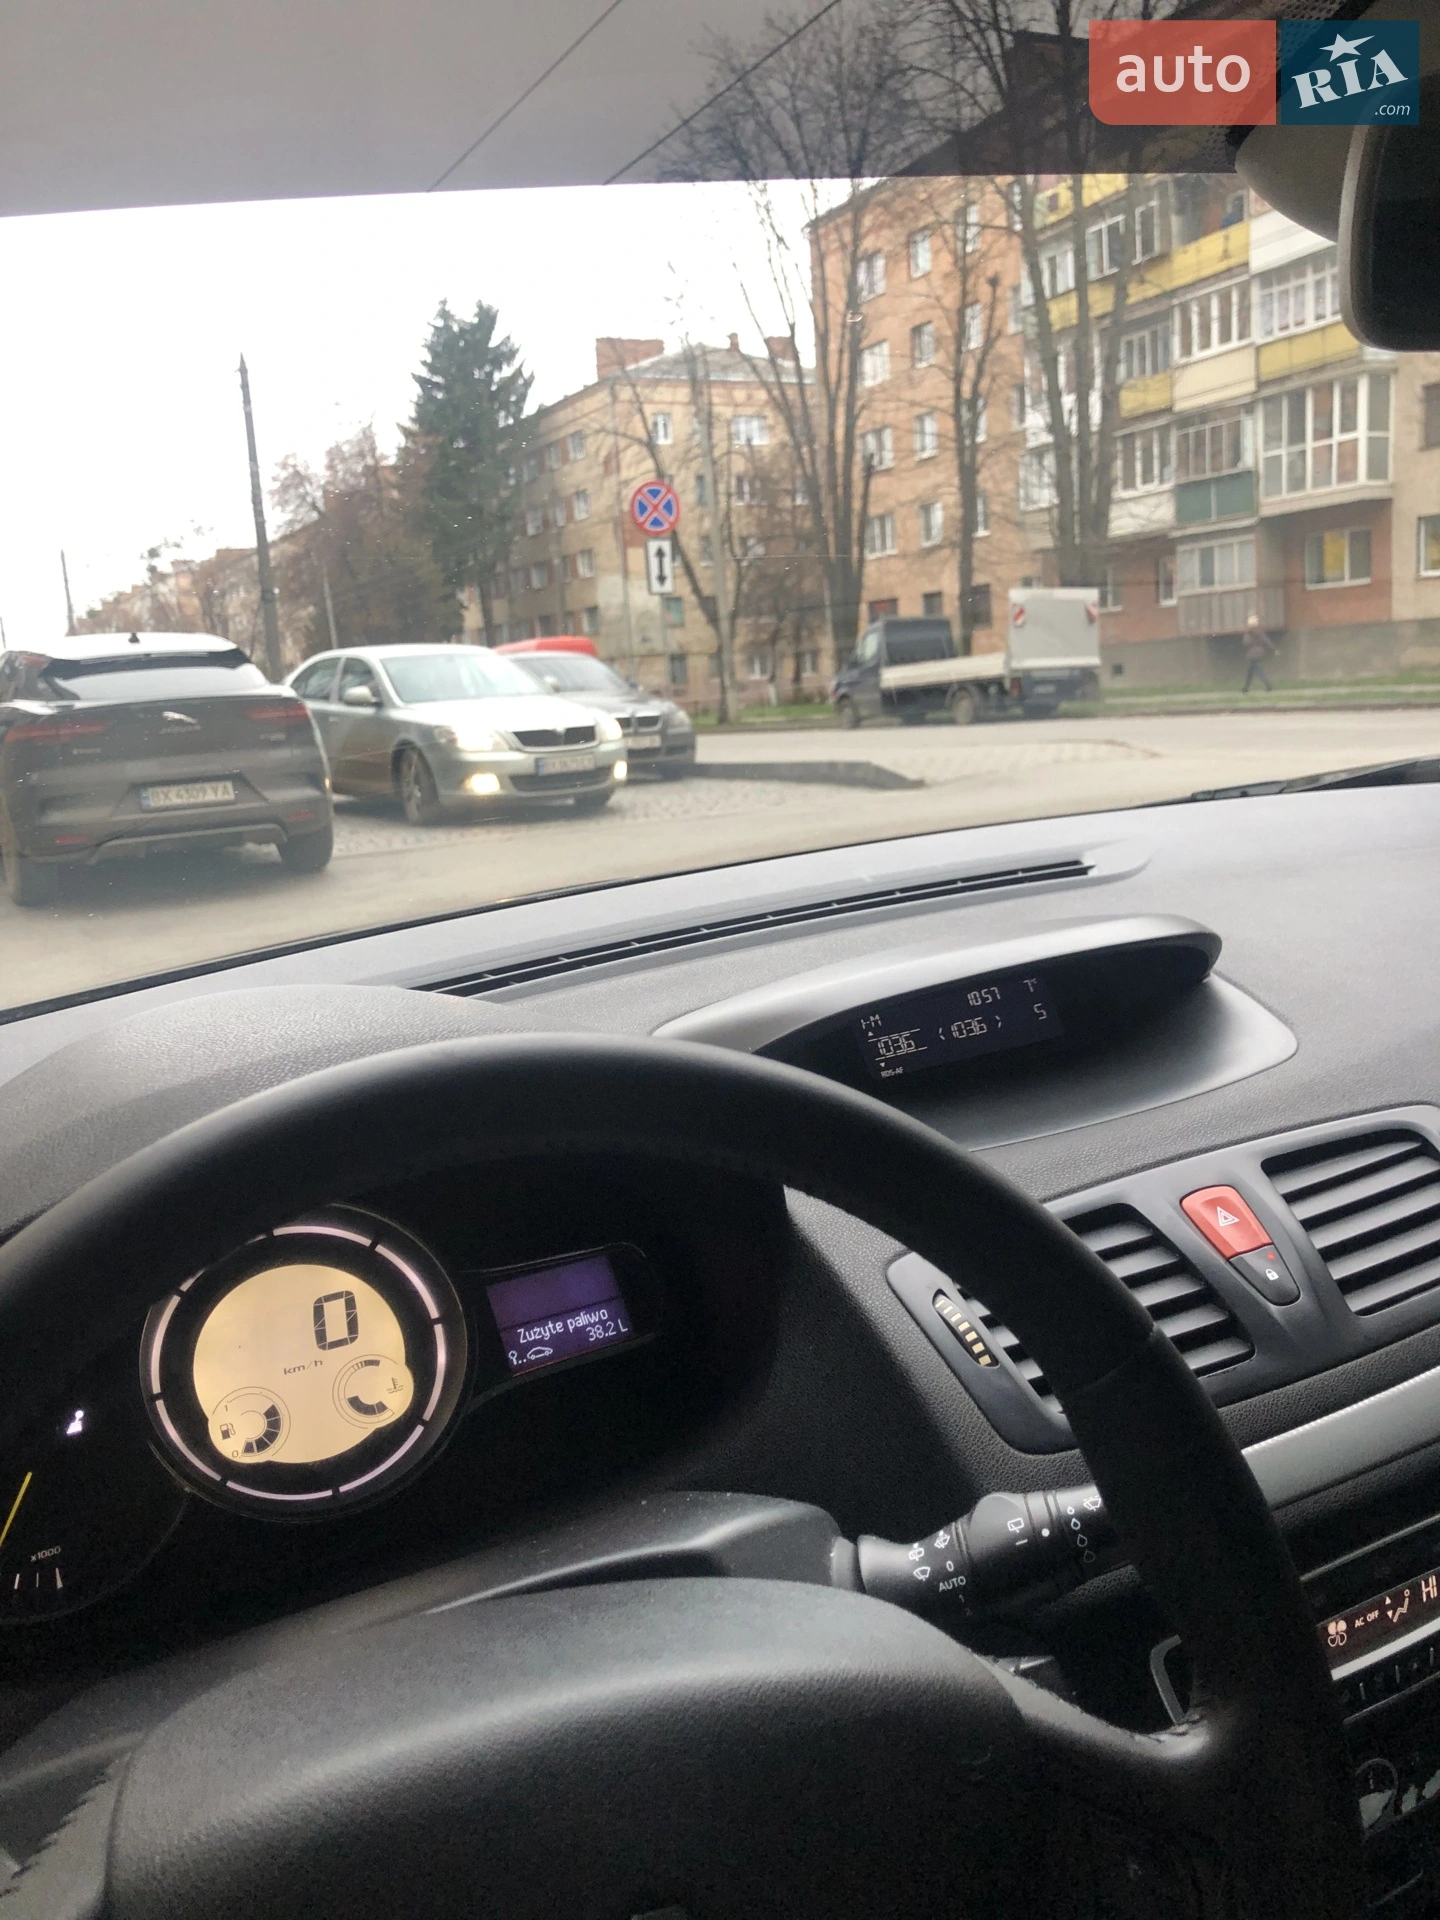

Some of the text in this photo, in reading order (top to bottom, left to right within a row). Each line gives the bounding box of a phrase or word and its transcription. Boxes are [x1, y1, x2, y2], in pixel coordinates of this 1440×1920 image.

[313, 1290, 359, 1351] 0
[517, 1309, 608, 1344] Zużyte paliwo
[586, 1319, 628, 1341] 38.2 L
[283, 1360, 324, 1376] km/h
[30, 1545, 61, 1562] x1000
[946, 1560, 954, 1571] 0
[938, 1576, 967, 1593] AUTO
[1354, 1609, 1380, 1629] AC OFF
